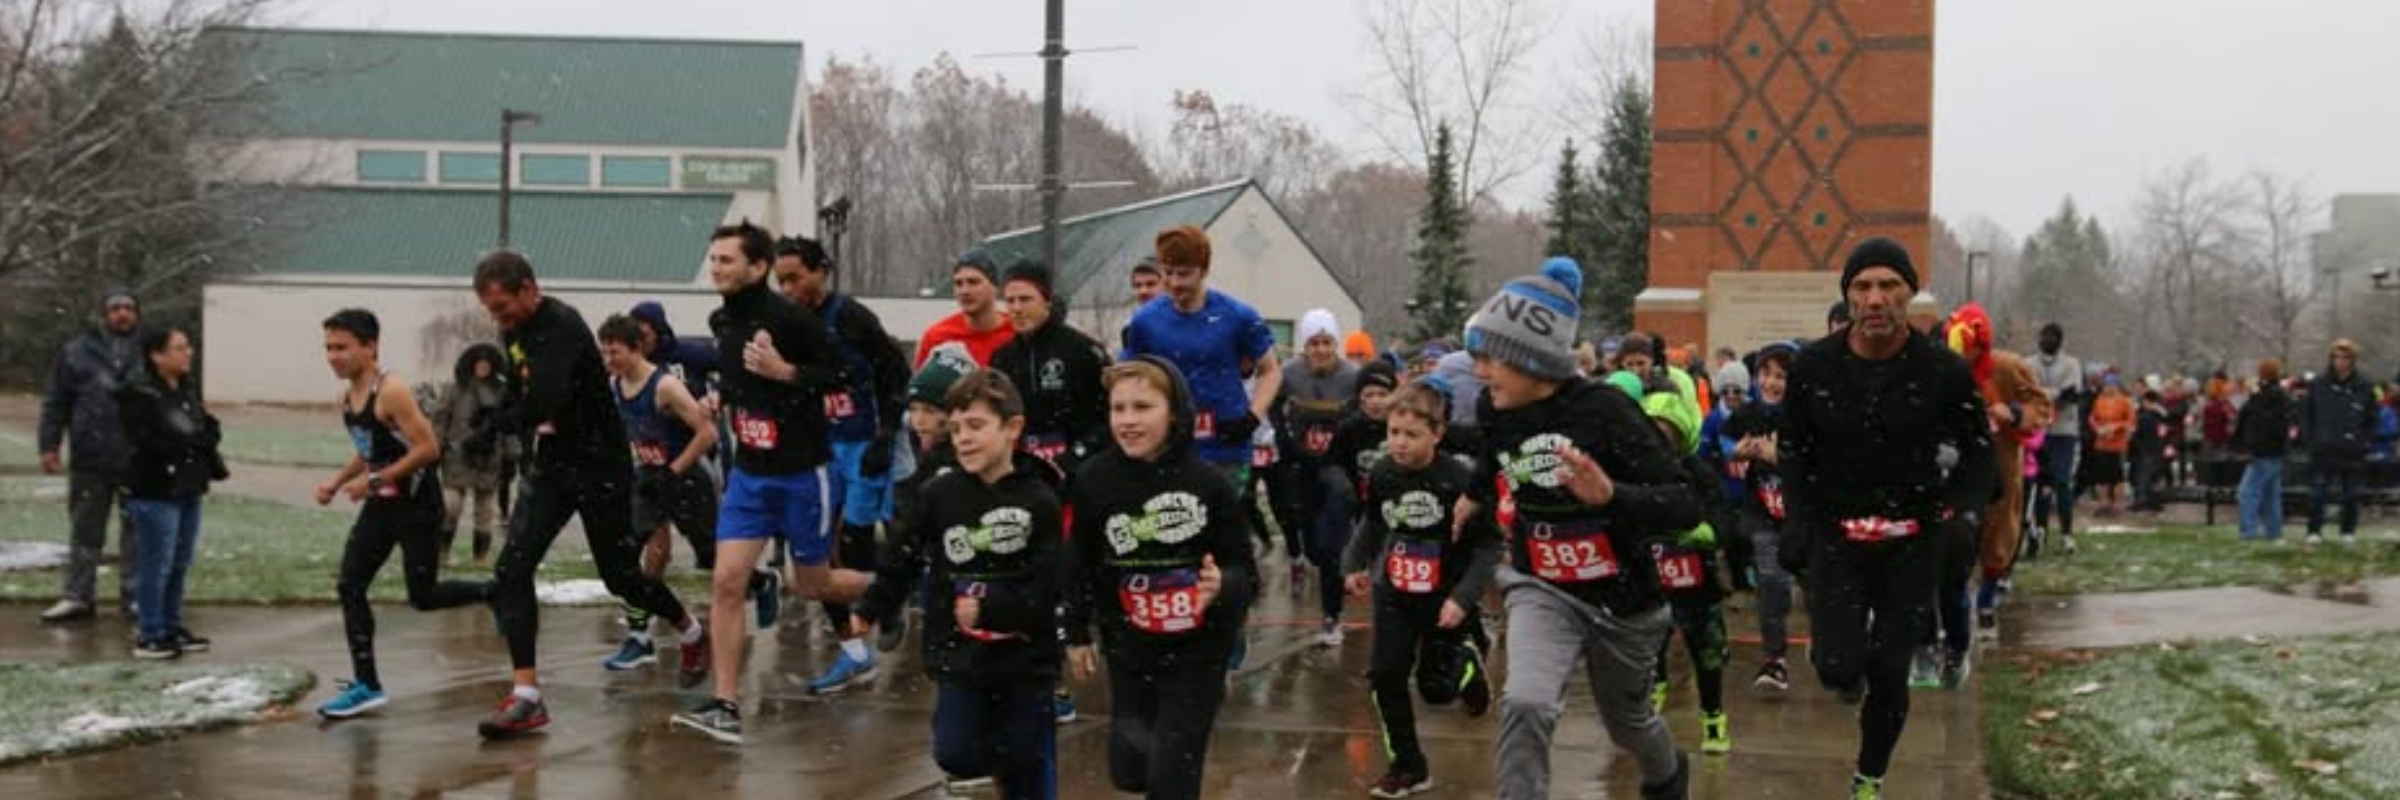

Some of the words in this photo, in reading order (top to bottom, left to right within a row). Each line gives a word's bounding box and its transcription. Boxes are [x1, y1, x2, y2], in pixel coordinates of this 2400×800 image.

[1489, 293, 1558, 336] NS
[1536, 539, 1603, 568] 382
[1130, 591, 1193, 619] 358
